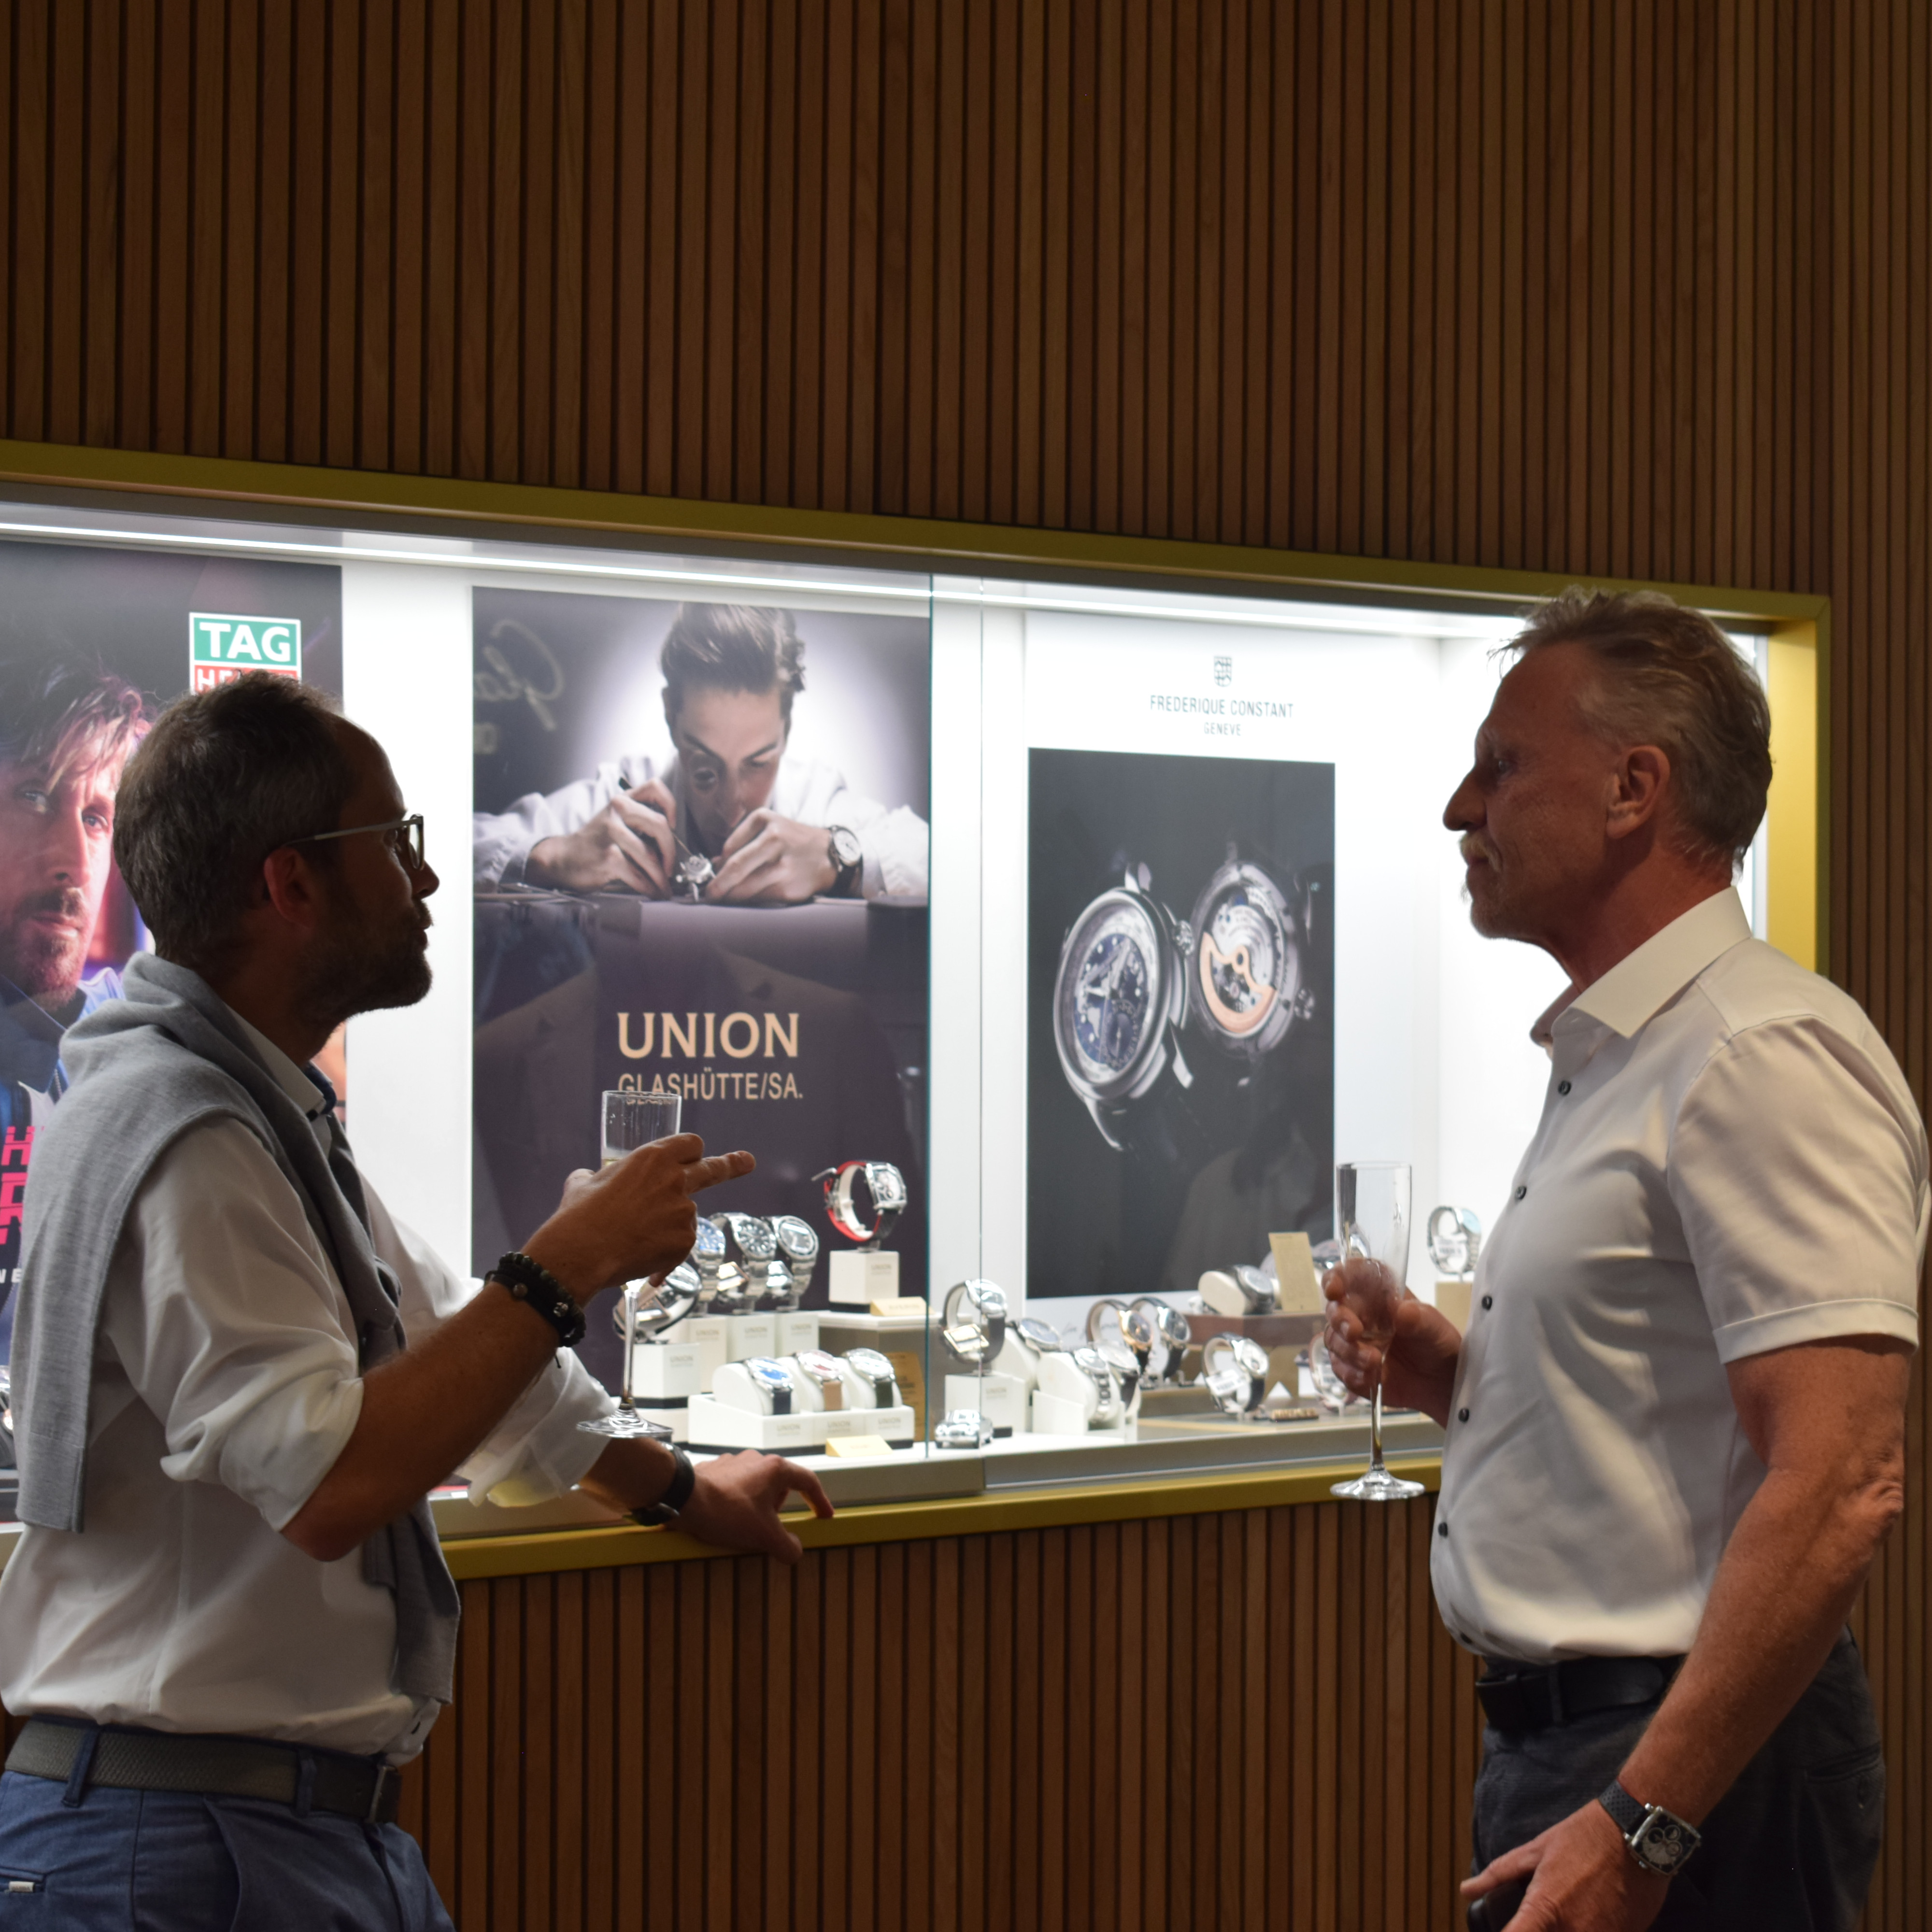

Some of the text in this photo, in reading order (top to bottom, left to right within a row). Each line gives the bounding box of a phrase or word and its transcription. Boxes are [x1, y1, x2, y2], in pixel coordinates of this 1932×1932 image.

[199, 621, 291, 663] TAG
[1150, 695, 1293, 718] FREDERIQUE CONSTANT
[1204, 722, 1241, 736] GENEVE
[617, 1012, 799, 1059] UNION
